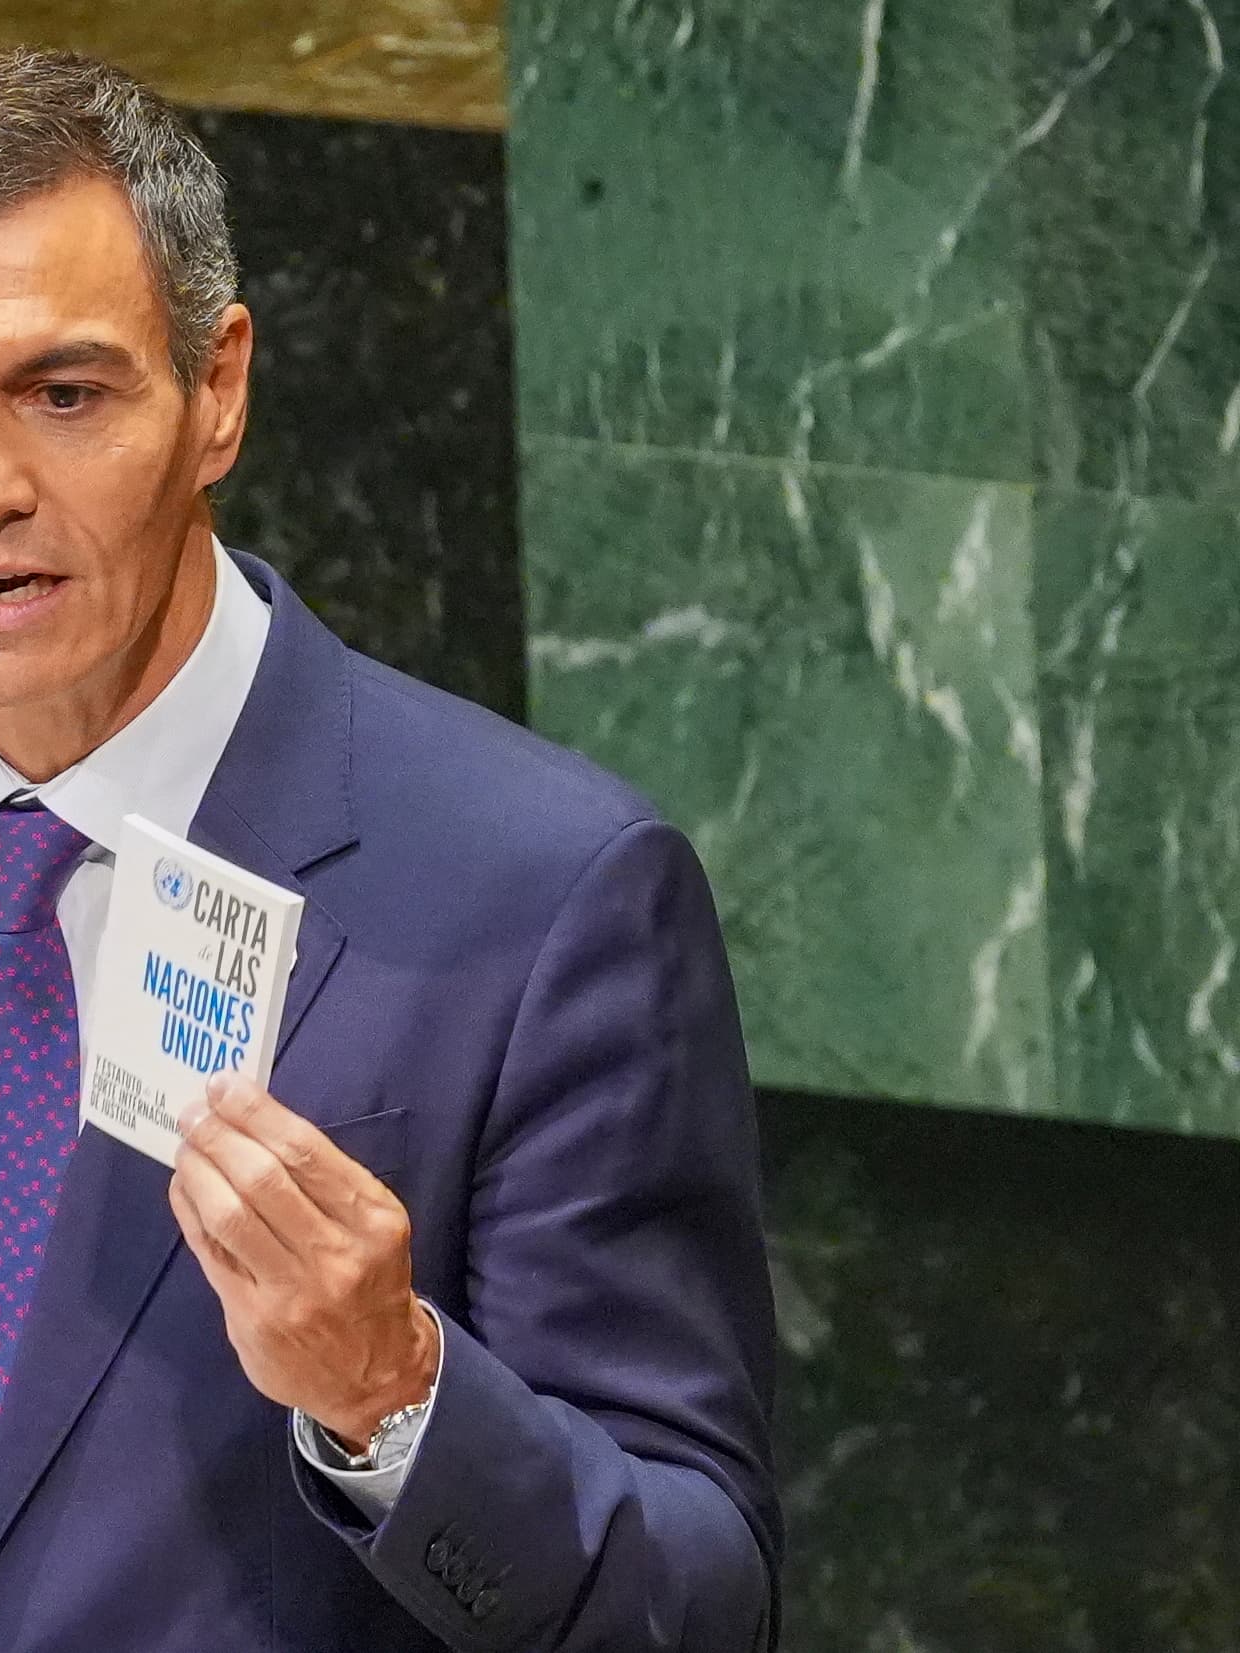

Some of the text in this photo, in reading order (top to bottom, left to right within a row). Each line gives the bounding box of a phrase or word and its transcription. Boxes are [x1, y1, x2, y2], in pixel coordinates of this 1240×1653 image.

[193, 879, 268, 955] CARTA
[143, 950, 255, 1044] NACIONES
[214, 939, 261, 998] LAS
[161, 1010, 245, 1074] UNIDAS
[90, 1089, 136, 1131] DE JUSTICIA
[92, 1071, 183, 1137] CORTE INTERNACIONA
[101, 1058, 142, 1095] ESTATUTO
[155, 1089, 167, 1110] LA
